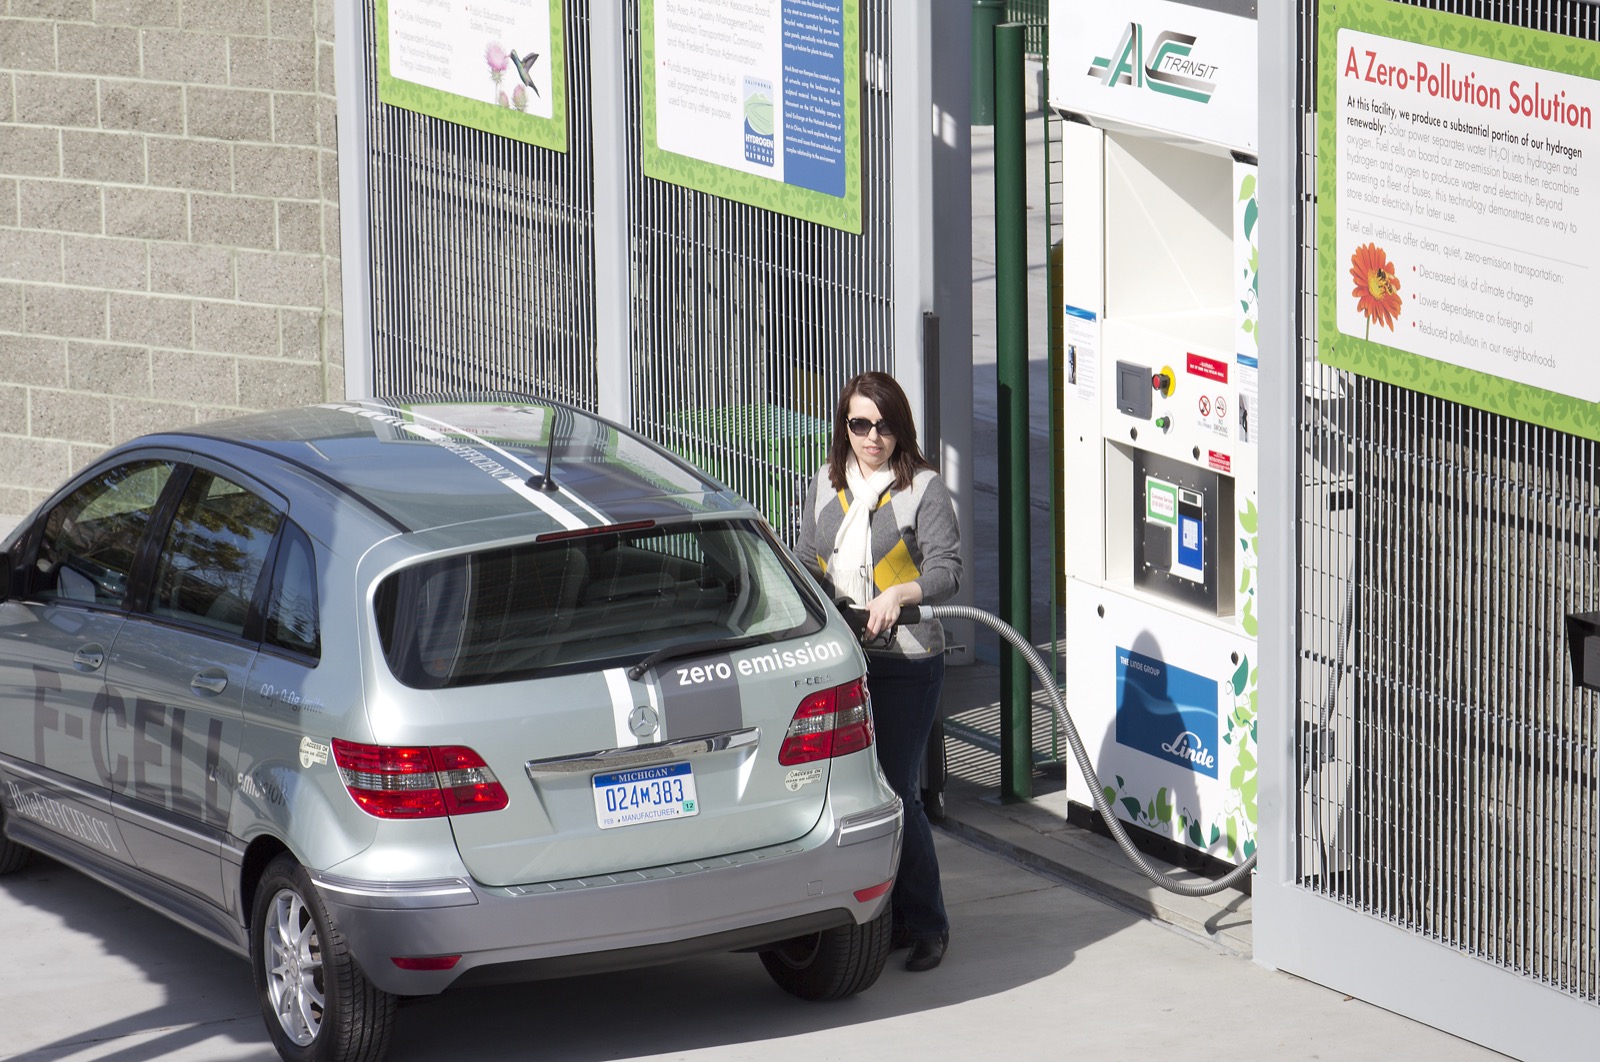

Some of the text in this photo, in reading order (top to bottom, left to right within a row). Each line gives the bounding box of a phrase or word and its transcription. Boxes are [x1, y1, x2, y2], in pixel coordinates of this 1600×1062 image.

[1087, 22, 1216, 104] AC
[1164, 55, 1218, 80] TRANSIT
[745, 80, 771, 89] CALIFORNIA
[1344, 46, 1592, 129] A Zero-Pollution Solution
[746, 134, 773, 148] HYDROGEN
[1347, 96, 1355, 108] At
[1357, 98, 1369, 111] this
[1372, 101, 1396, 120] facility,
[1399, 111, 1409, 120] we
[1412, 112, 1440, 126] produce
[1450, 120, 1489, 137] substantial
[1492, 131, 1518, 144] portion
[1521, 135, 1528, 146] of
[1531, 140, 1543, 149] our
[1546, 140, 1582, 159] hydrogen
[1347, 117, 1386, 136] renewably:
[1387, 123, 1406, 137] Solar
[1408, 131, 1430, 143] power
[1432, 137, 1465, 151] separates
[1467, 144, 1486, 156] water
[1512, 150, 1525, 164] into
[1527, 154, 1560, 174] hydrogen
[1563, 165, 1577, 176] and
[746, 144, 773, 156] HIGHWAY
[746, 152, 773, 163] NETWORK
[1347, 136, 1579, 196] oxygen. Fuel cells on board our zero-emission buses then recombine
[1347, 149, 1563, 211] hydrogen and oxygen to produce water and electricity. Beyond
[1347, 172, 1378, 189] powering
[1387, 177, 1401, 191] fleet
[1403, 182, 1410, 193] of
[1411, 183, 1433, 201] buses,
[1436, 189, 1447, 202] this
[1449, 192, 1487, 215] technology
[1488, 201, 1534, 222] demonstrates
[1536, 217, 1550, 226] one
[1552, 221, 1568, 234] way
[1570, 221, 1577, 232] to
[1347, 187, 1457, 223] store solar electricity for later use.
[1347, 219, 1563, 284] Fuel cell vehicles offer clean, quiet, zero-emission transportation:
[1419, 265, 1533, 307] Decreased risk of climate change
[1419, 293, 1533, 333] Lower dependence on foreign oil
[1419, 321, 1556, 368] Reduced pollution in our neighborhoods
[677, 640, 843, 686] zero emission
[1120, 656, 1160, 676] THE LINDE GROUP
[32, 664, 232, 830] F-CELL
[307, 742, 321, 750] ACCESS
[1161, 731, 1214, 768] Linde
[606, 779, 684, 812] 024M383
[619, 768, 668, 782] MICHIGAN
[7, 781, 118, 853] BlueEFFICIENCY
[622, 808, 675, 822] MANUFACTURER
